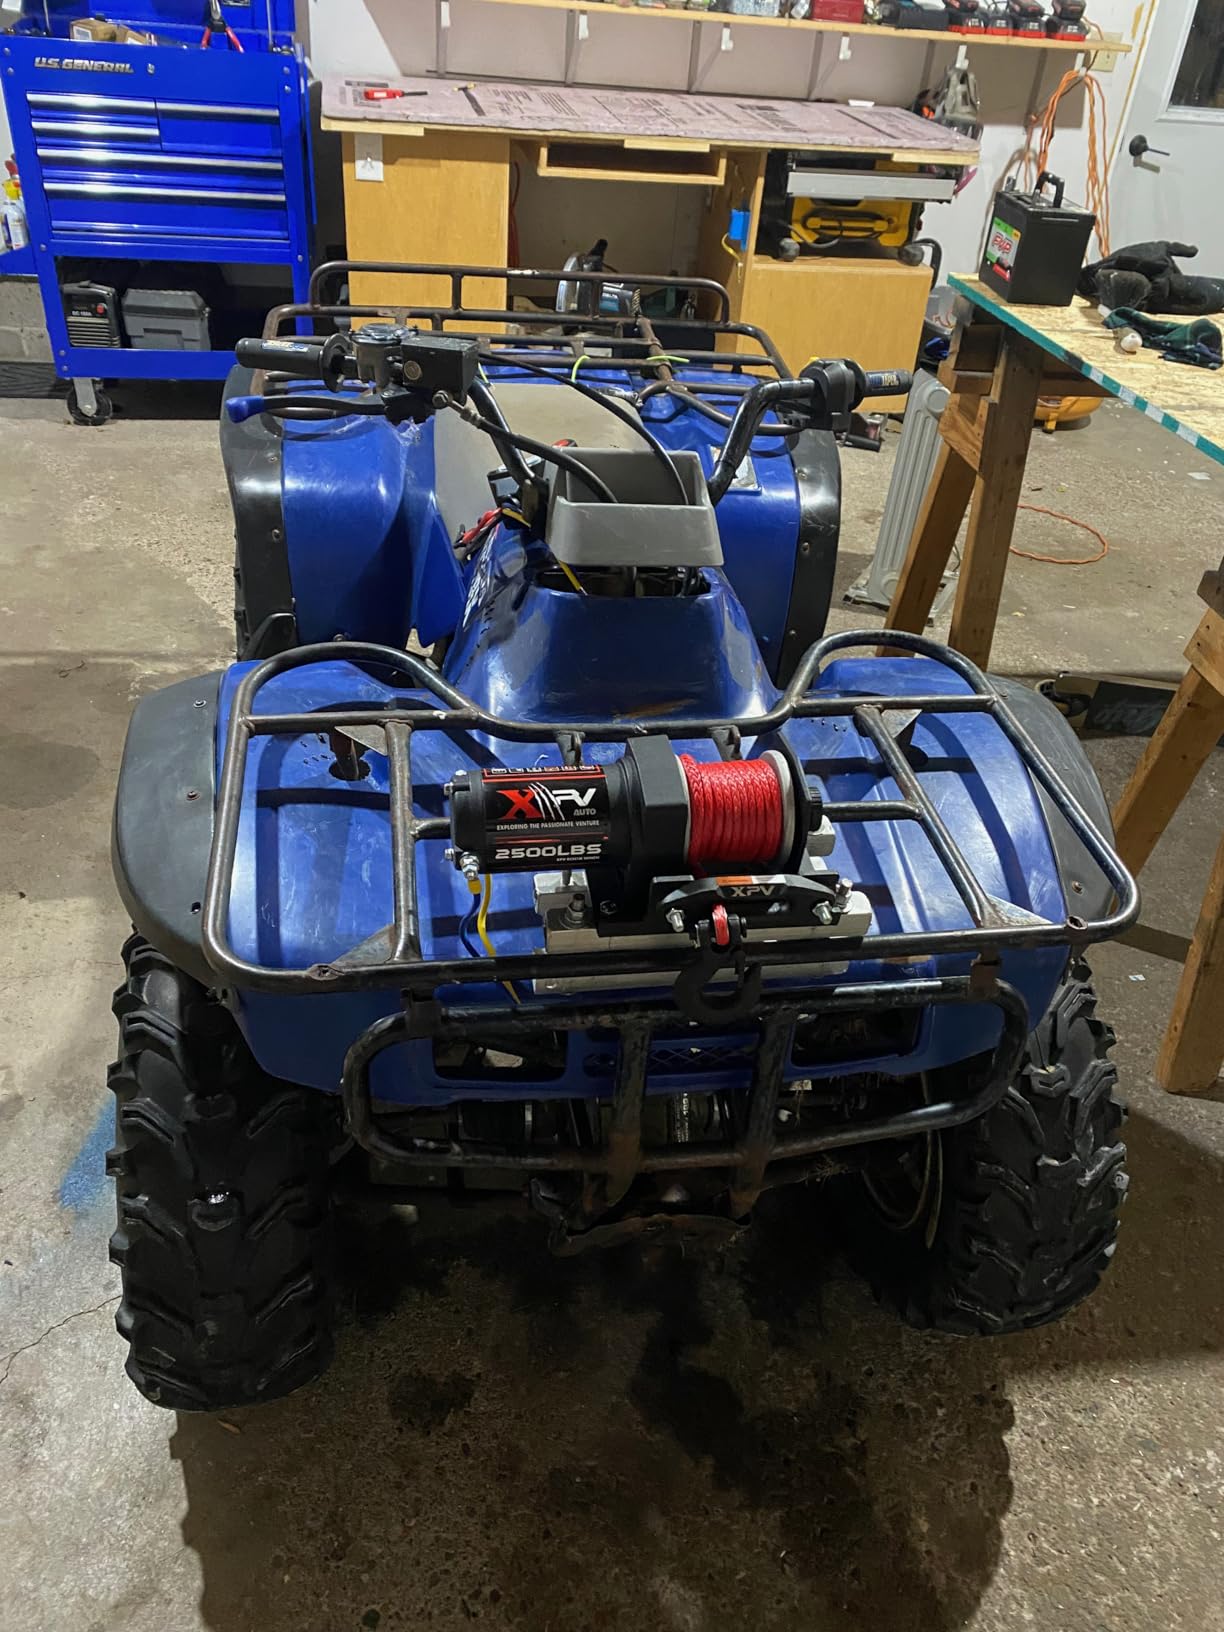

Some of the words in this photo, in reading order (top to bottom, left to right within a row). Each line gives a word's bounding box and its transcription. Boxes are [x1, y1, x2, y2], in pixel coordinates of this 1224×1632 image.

[62, 59, 134, 74] GENERAL
[497, 823, 528, 831] EXPLORING
[495, 844, 602, 860] 2500LBS
[731, 885, 775, 897] XPV
